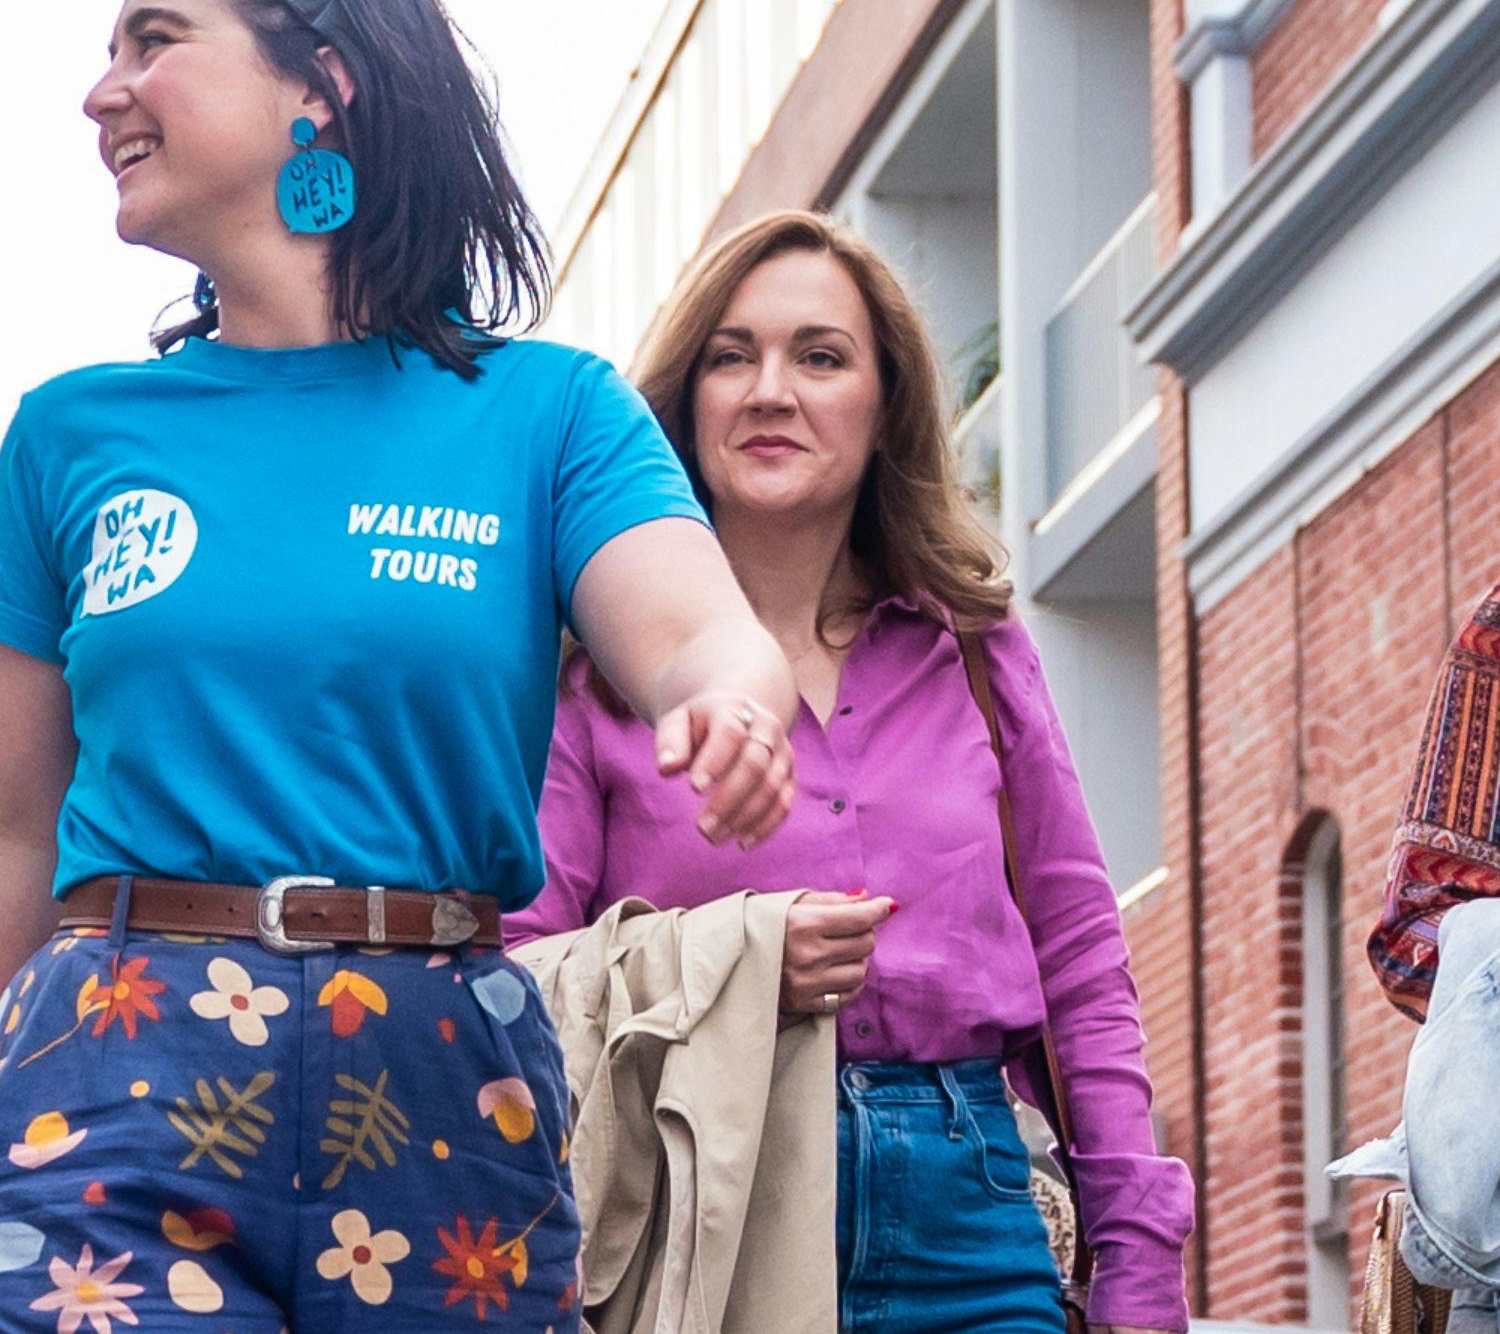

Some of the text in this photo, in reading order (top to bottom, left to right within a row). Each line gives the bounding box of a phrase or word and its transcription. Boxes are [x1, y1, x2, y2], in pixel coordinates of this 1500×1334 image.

[293, 161, 346, 214] HEY!
[312, 203, 345, 228] WA
[105, 496, 144, 539] OH
[347, 503, 500, 545] WALKING
[93, 509, 177, 586] HEY!
[107, 564, 156, 605] WA
[370, 548, 478, 591] TOURS
